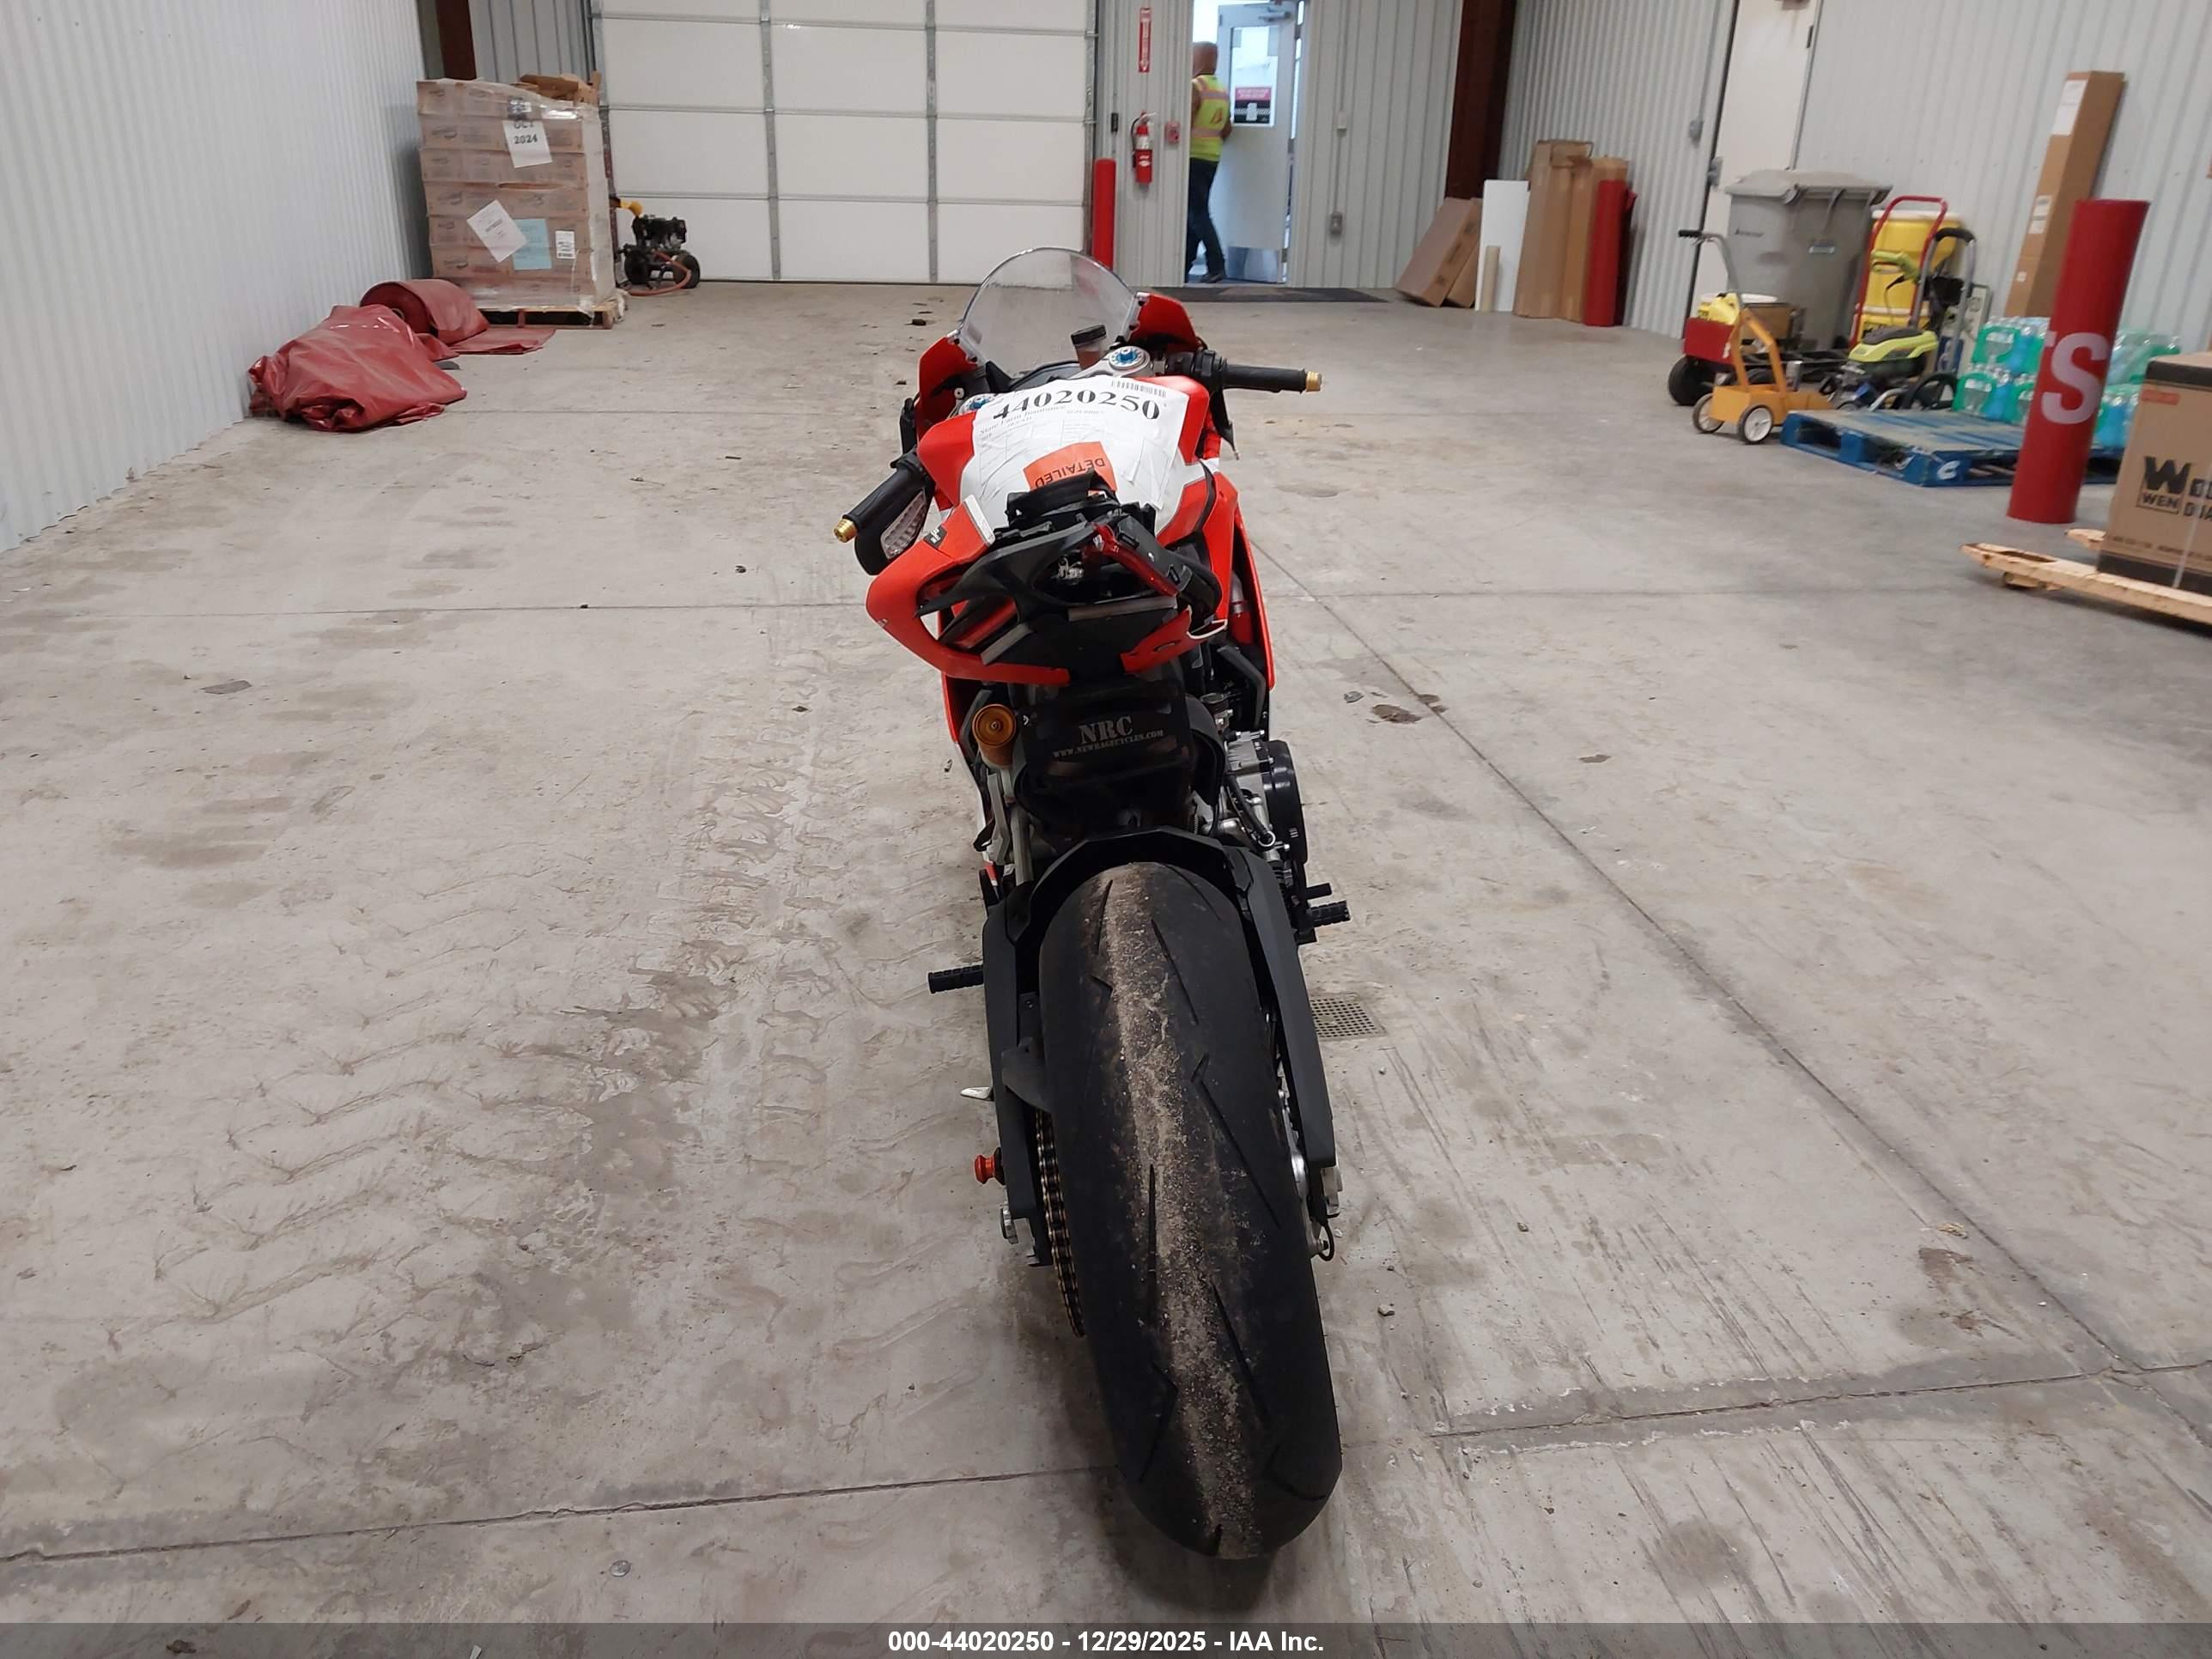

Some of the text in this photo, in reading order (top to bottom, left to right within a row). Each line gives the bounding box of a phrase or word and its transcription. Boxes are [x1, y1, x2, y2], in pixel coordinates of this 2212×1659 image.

[514, 134, 538, 144] 2024
[993, 389, 1160, 420] 44020250
[1035, 458, 1105, 488] DETAILED
[1079, 716, 1133, 744] NRC
